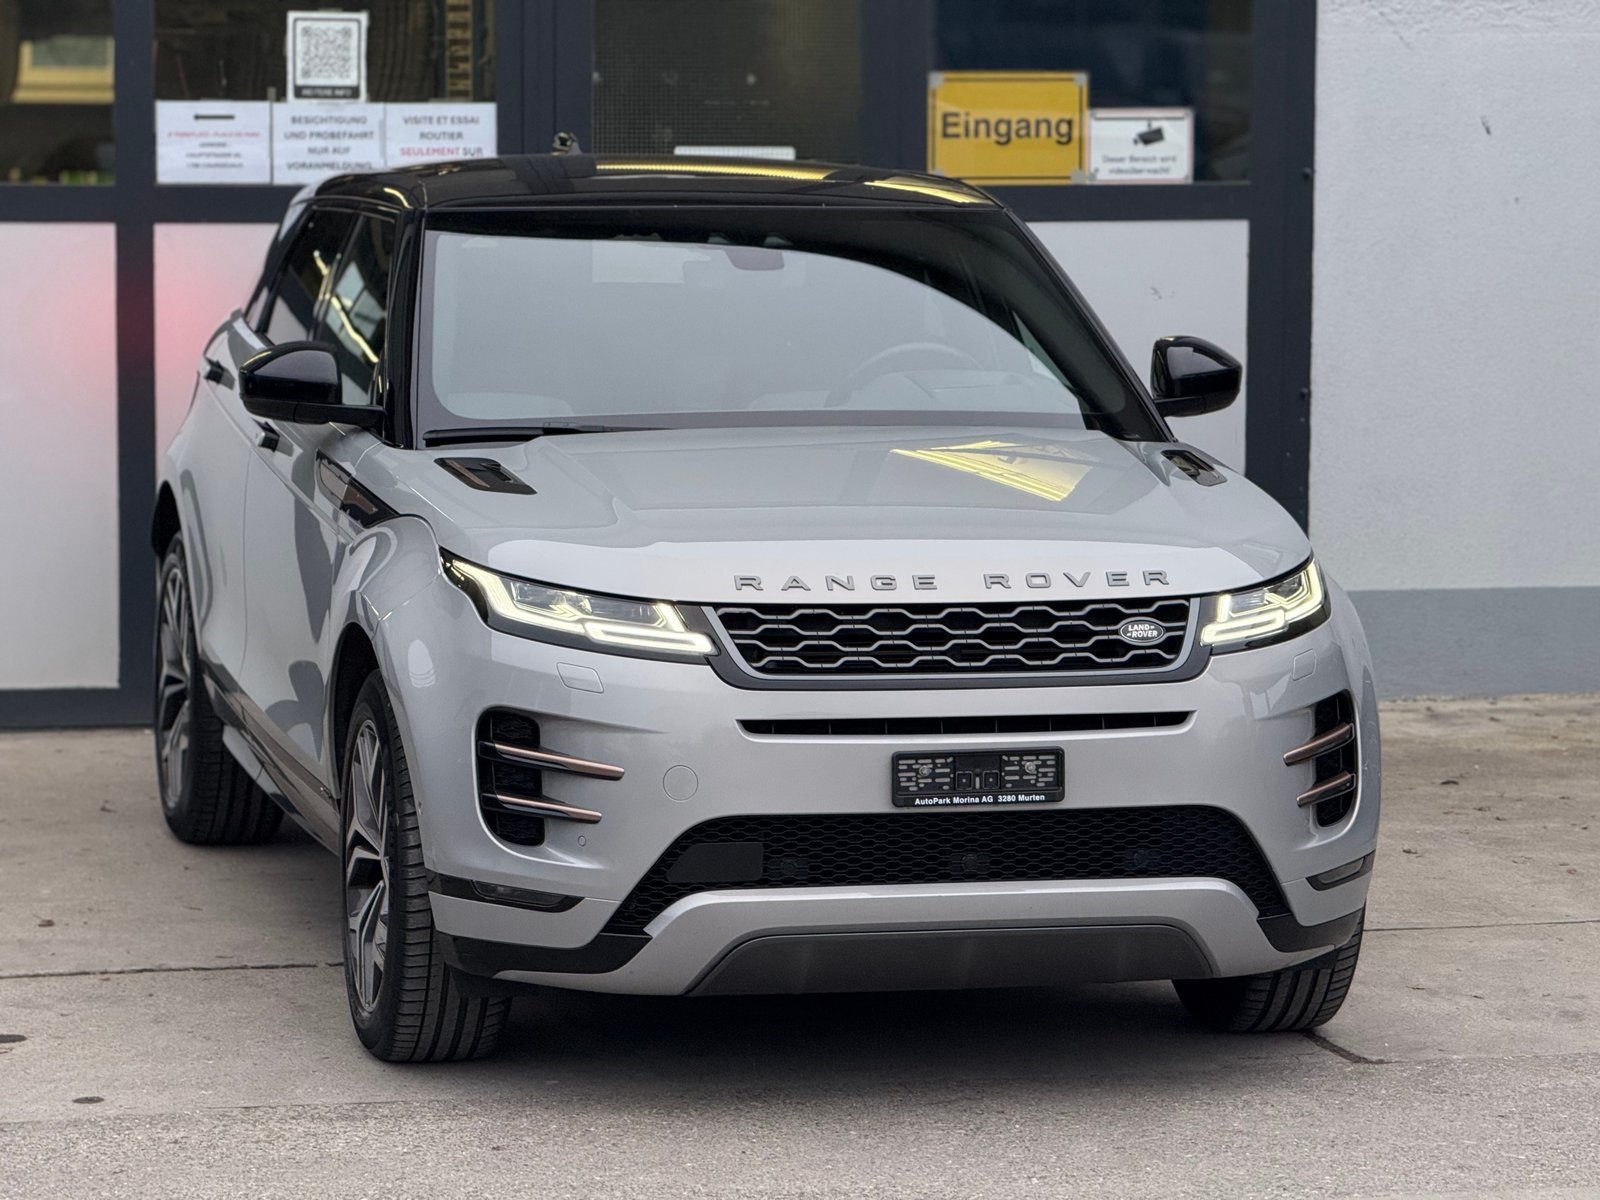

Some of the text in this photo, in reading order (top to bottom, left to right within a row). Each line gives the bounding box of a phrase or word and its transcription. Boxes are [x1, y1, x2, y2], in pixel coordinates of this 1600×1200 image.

[291, 116, 367, 125] BESICHTIGUNG
[402, 116, 480, 125] VISITE ET ESSAI
[941, 112, 1073, 145] Eingang
[284, 131, 374, 140] UND PROBEFAHRT
[419, 131, 463, 140] ROUTIER
[307, 146, 351, 155] NUR AUF
[400, 147, 483, 157] SEULEMENT SUR
[287, 161, 373, 170] VORANMELDUNG
[733, 570, 1170, 591] RANGE ROVER
[914, 797, 951, 805] AutoPark
[953, 795, 979, 804] Morina
[981, 795, 993, 803] AG
[997, 794, 1016, 802] 3280
